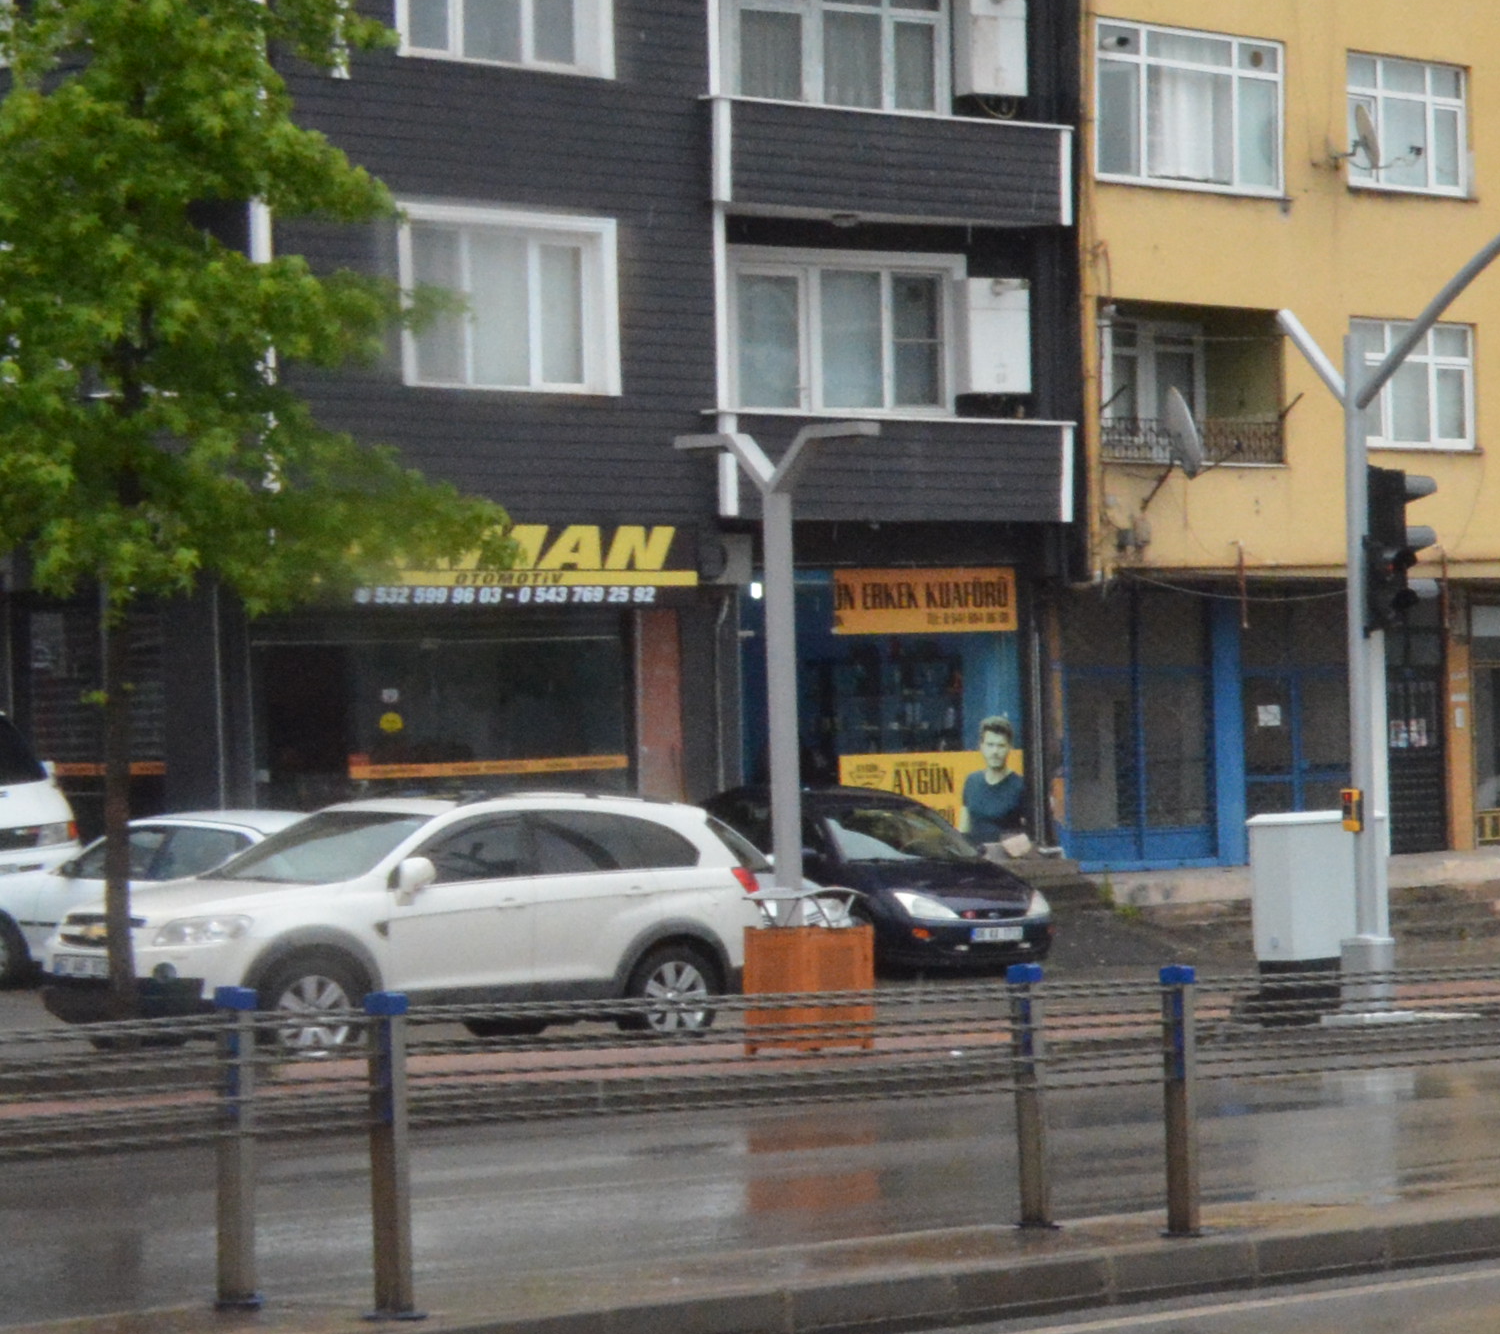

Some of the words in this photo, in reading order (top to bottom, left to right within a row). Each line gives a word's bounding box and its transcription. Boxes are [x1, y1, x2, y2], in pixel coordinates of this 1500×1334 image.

[413, 586, 448, 603] 599
[452, 586, 475, 603] 96
[478, 586, 503, 603] 03
[519, 586, 531, 603] 0
[534, 586, 568, 603] 543
[573, 586, 605, 603] 769
[607, 586, 630, 603] 25
[633, 586, 656, 602] 92
[862, 581, 919, 610] ERKEK
